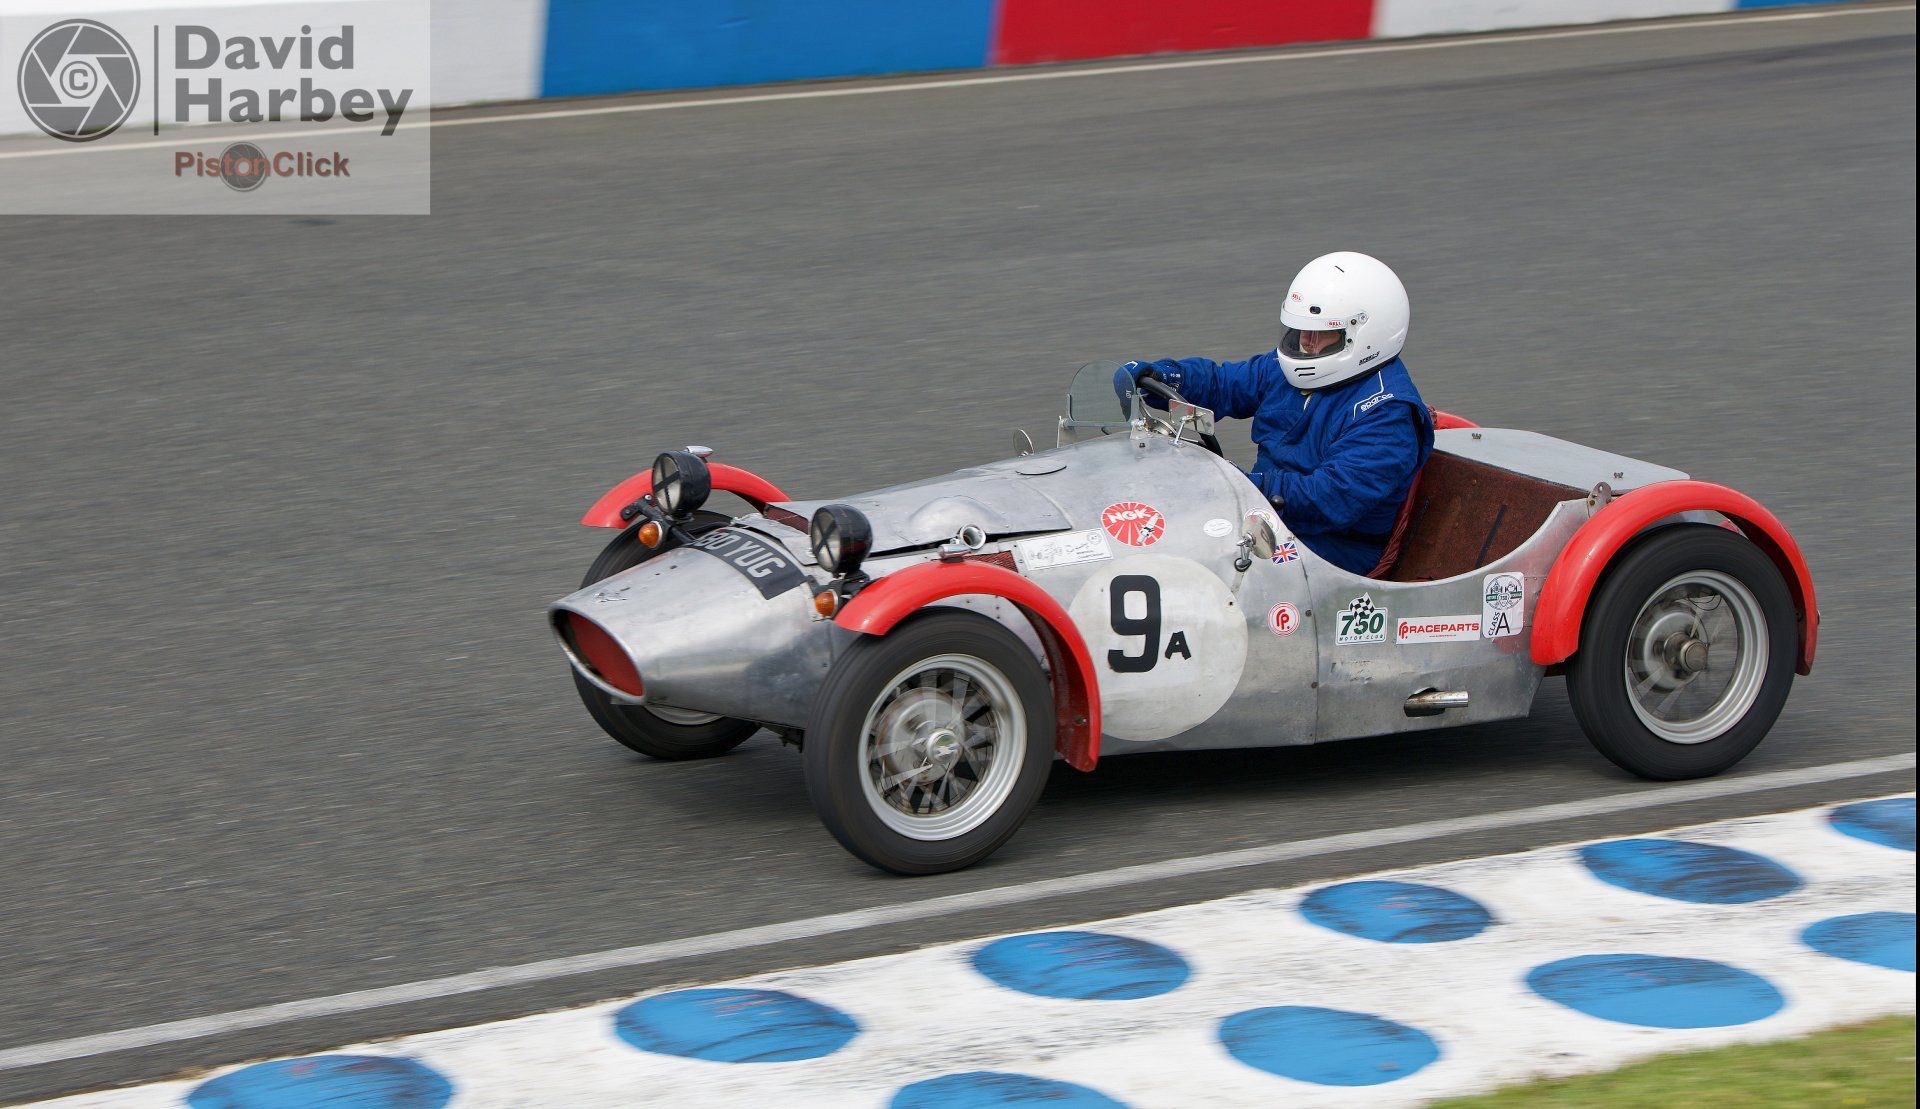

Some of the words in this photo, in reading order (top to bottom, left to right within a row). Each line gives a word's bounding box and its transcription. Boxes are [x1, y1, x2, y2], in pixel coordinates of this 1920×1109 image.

[1107, 506, 1153, 525] NGK
[723, 540, 787, 578] YUG
[1107, 574, 1162, 674] 9
[1164, 630, 1192, 661] A
[1341, 612, 1385, 636] 750
[1409, 622, 1480, 634] RACEPARTS
[1487, 611, 1501, 636] CLASS
[1494, 612, 1511, 636] A
